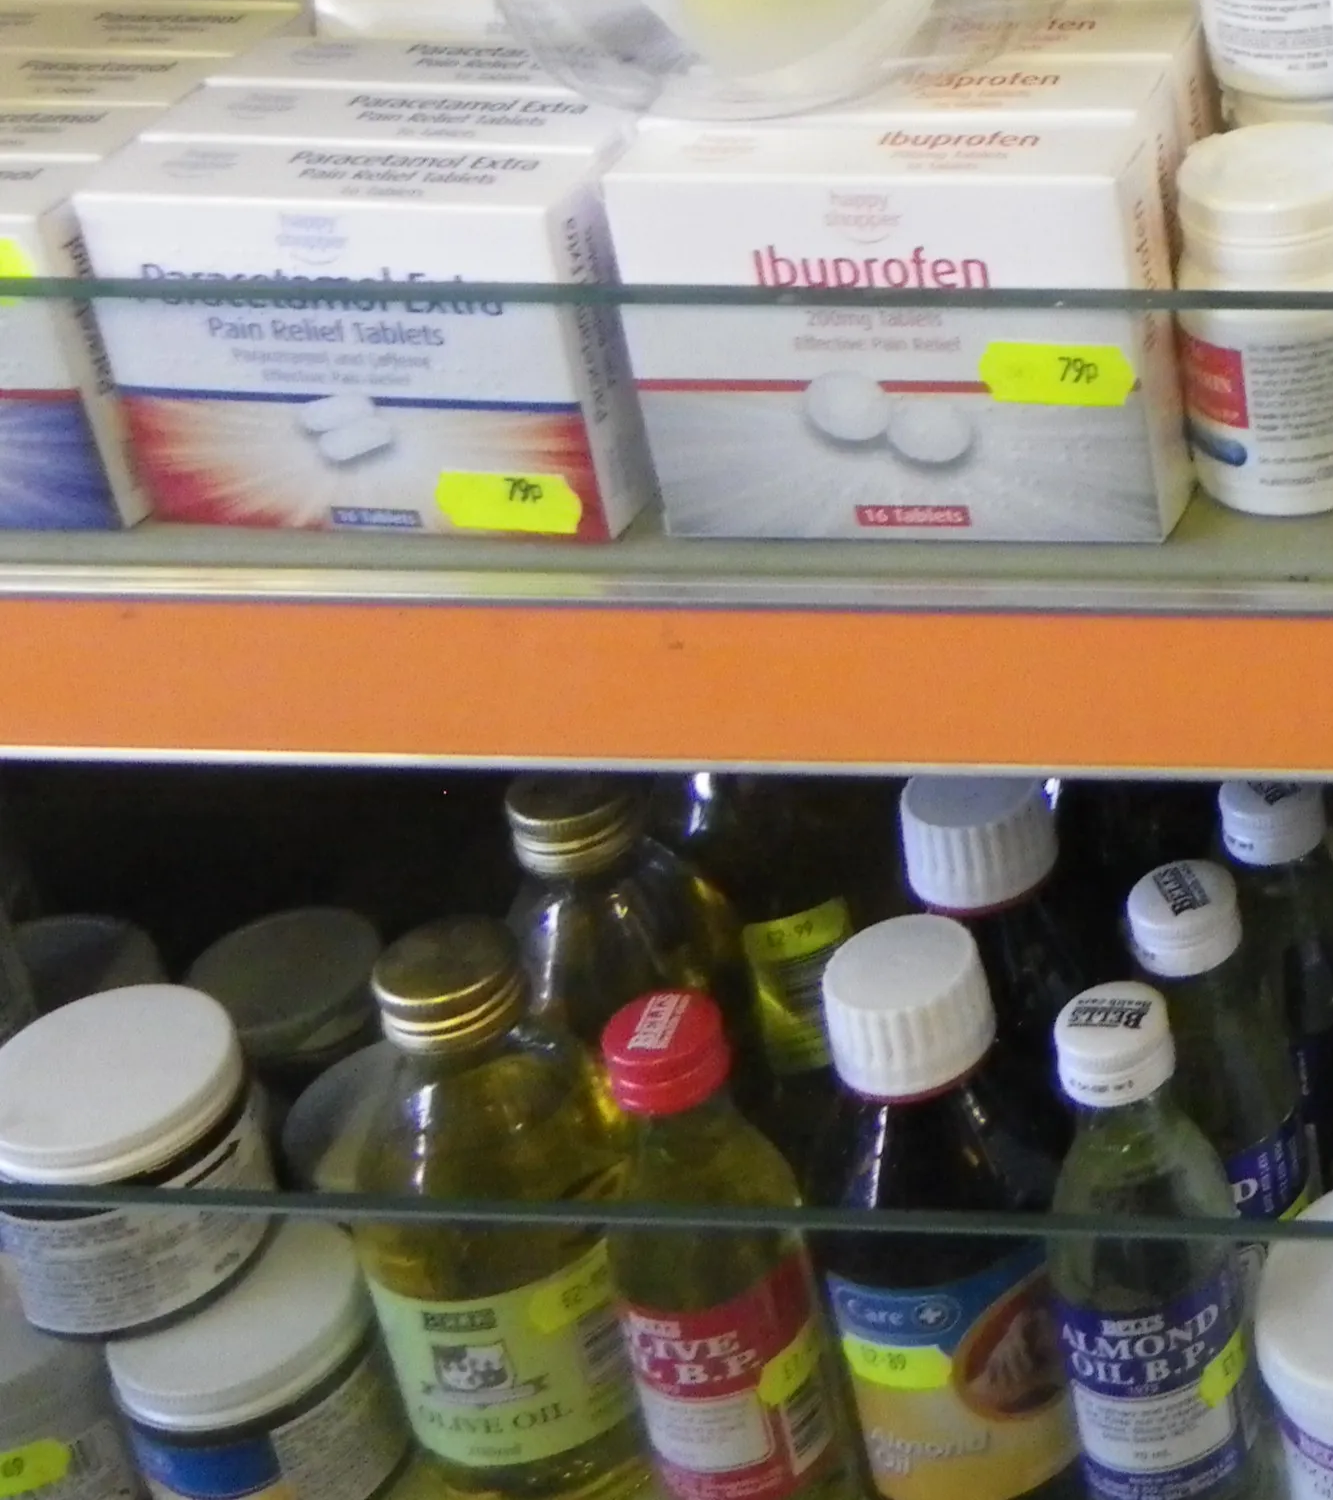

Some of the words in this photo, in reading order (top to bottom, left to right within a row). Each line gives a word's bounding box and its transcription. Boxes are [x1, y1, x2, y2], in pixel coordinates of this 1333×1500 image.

[348, 94, 518, 112] Paracetamol
[520, 99, 589, 115] Extra
[878, 130, 1041, 150] Ibuprofen
[288, 150, 465, 169] Paracetamol
[469, 155, 541, 172] Extra
[752, 245, 991, 290] Ibuprofen
[208, 316, 264, 341] Pain
[270, 318, 345, 343] Relief
[352, 321, 446, 347] Tablets
[1062, 1304, 1219, 1361] ALMOND
[1069, 1349, 1134, 1387] OIL
[512, 1402, 576, 1431] OIL
[869, 1428, 990, 1458] Almond
